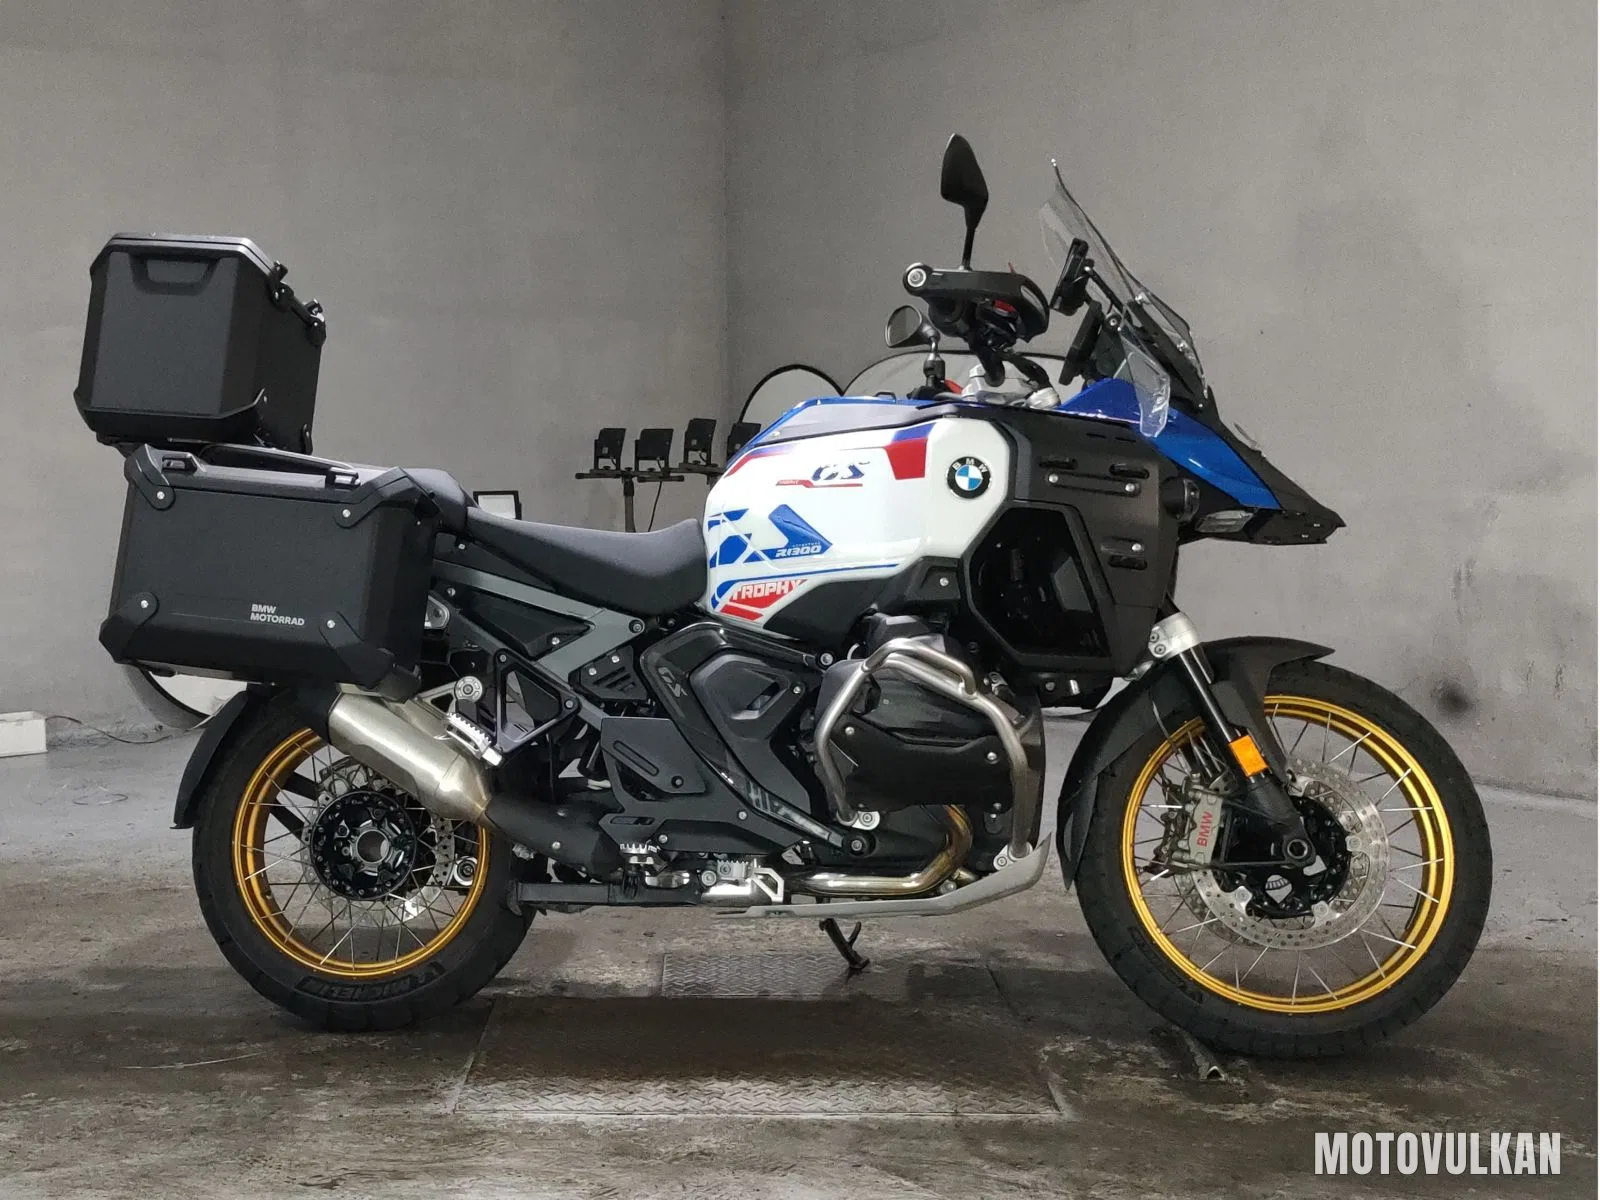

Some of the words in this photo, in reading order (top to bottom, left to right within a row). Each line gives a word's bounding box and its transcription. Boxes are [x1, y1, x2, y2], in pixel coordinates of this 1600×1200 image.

[952, 457, 988, 473] BMW
[775, 545, 822, 558] R1300
[731, 579, 805, 604] TROPHY
[250, 603, 276, 614] BMW
[249, 612, 305, 626] MOTORRAD
[1197, 811, 1214, 848] BMW
